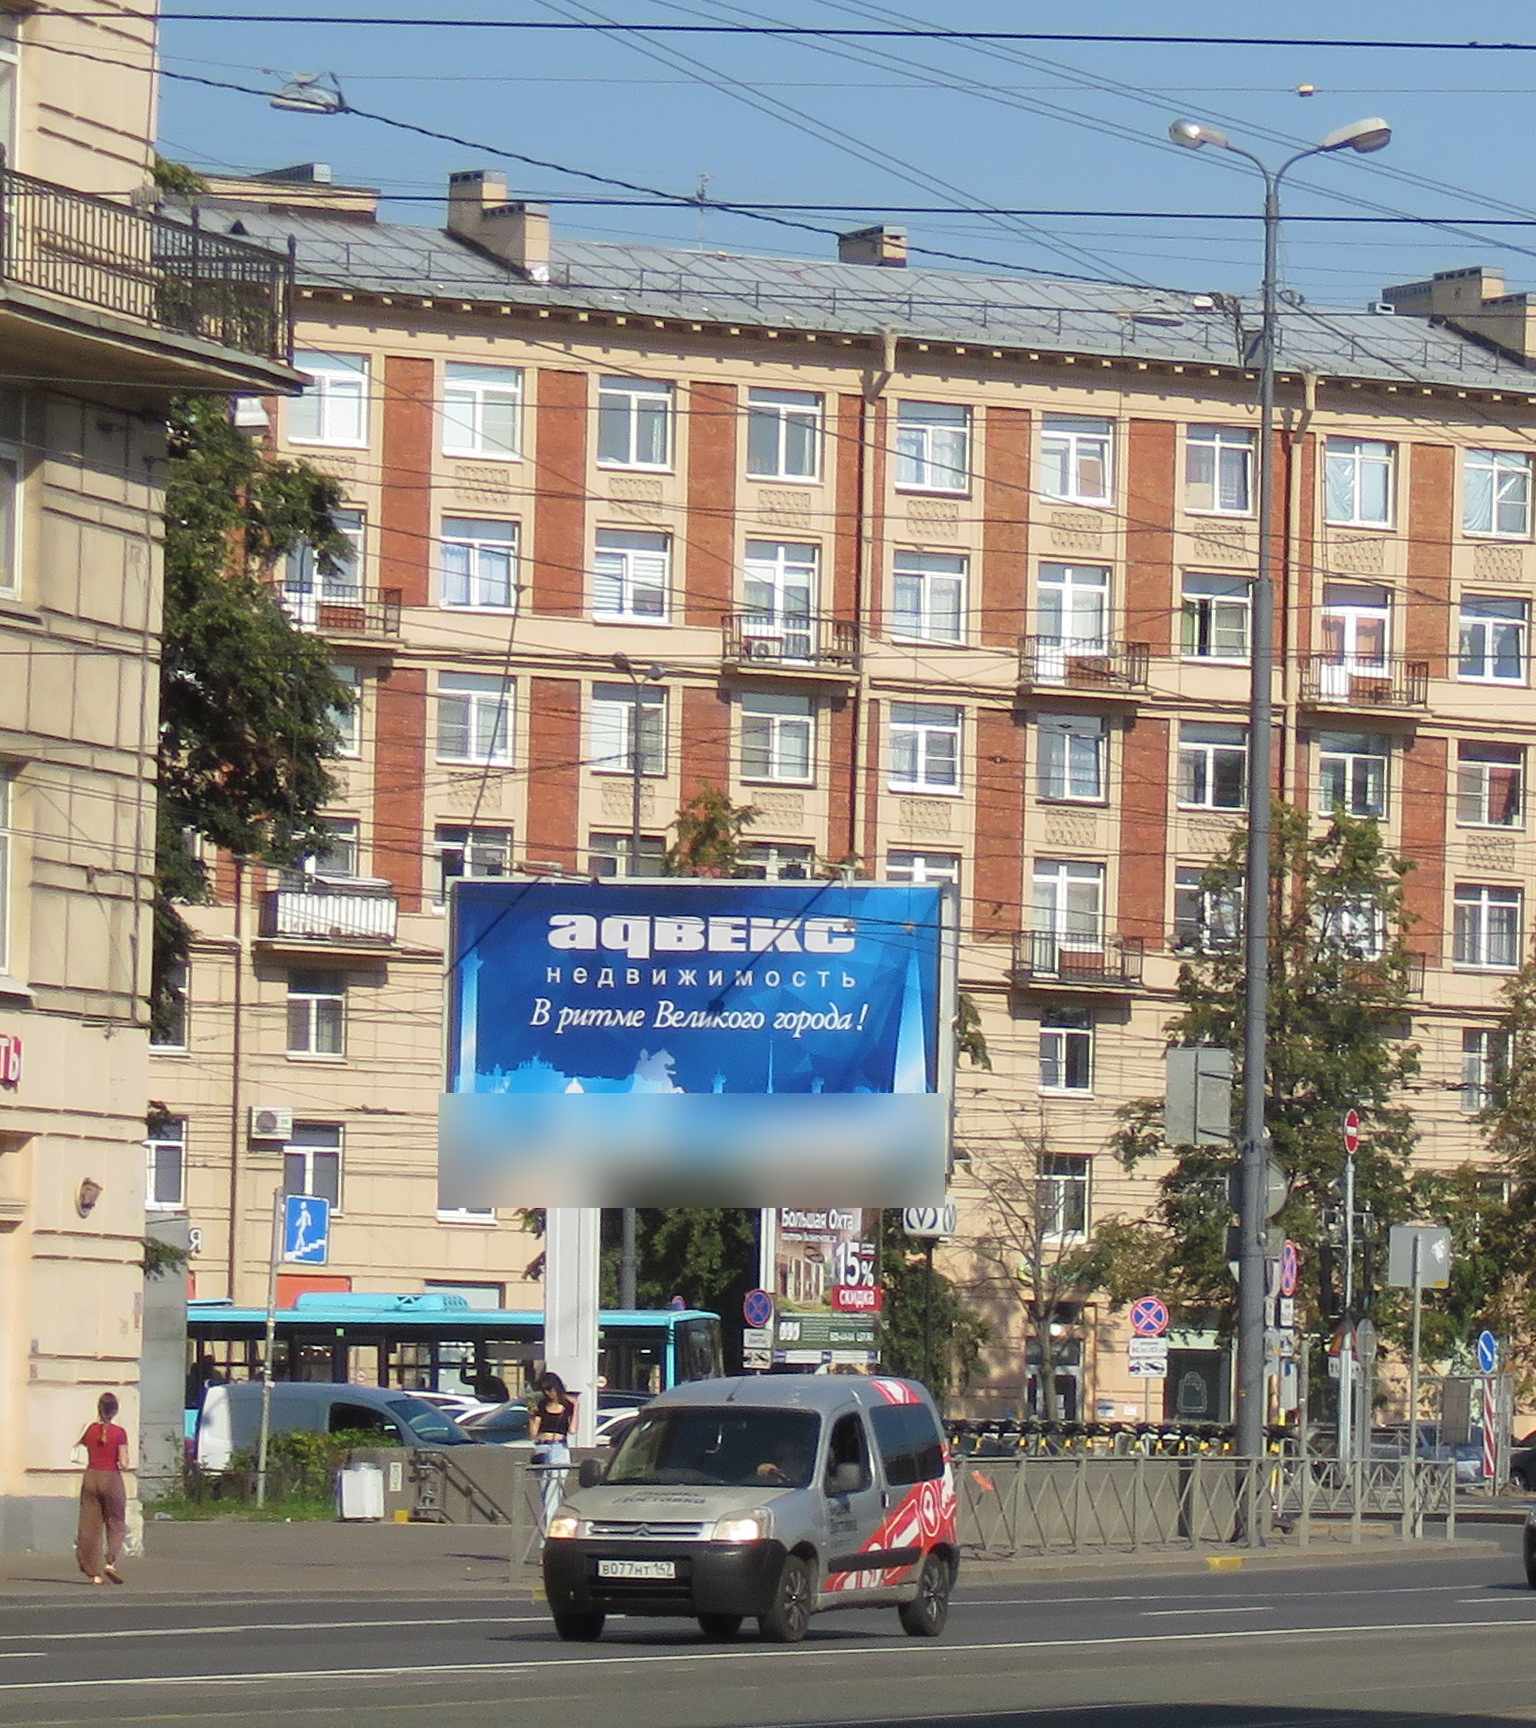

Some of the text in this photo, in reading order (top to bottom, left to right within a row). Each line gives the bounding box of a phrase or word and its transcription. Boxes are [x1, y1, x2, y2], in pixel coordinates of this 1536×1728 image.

[546, 966, 856, 988] недвижимость
[530, 998, 551, 1028] В
[555, 1007, 645, 1034] ритме
[653, 998, 765, 1030] Великого
